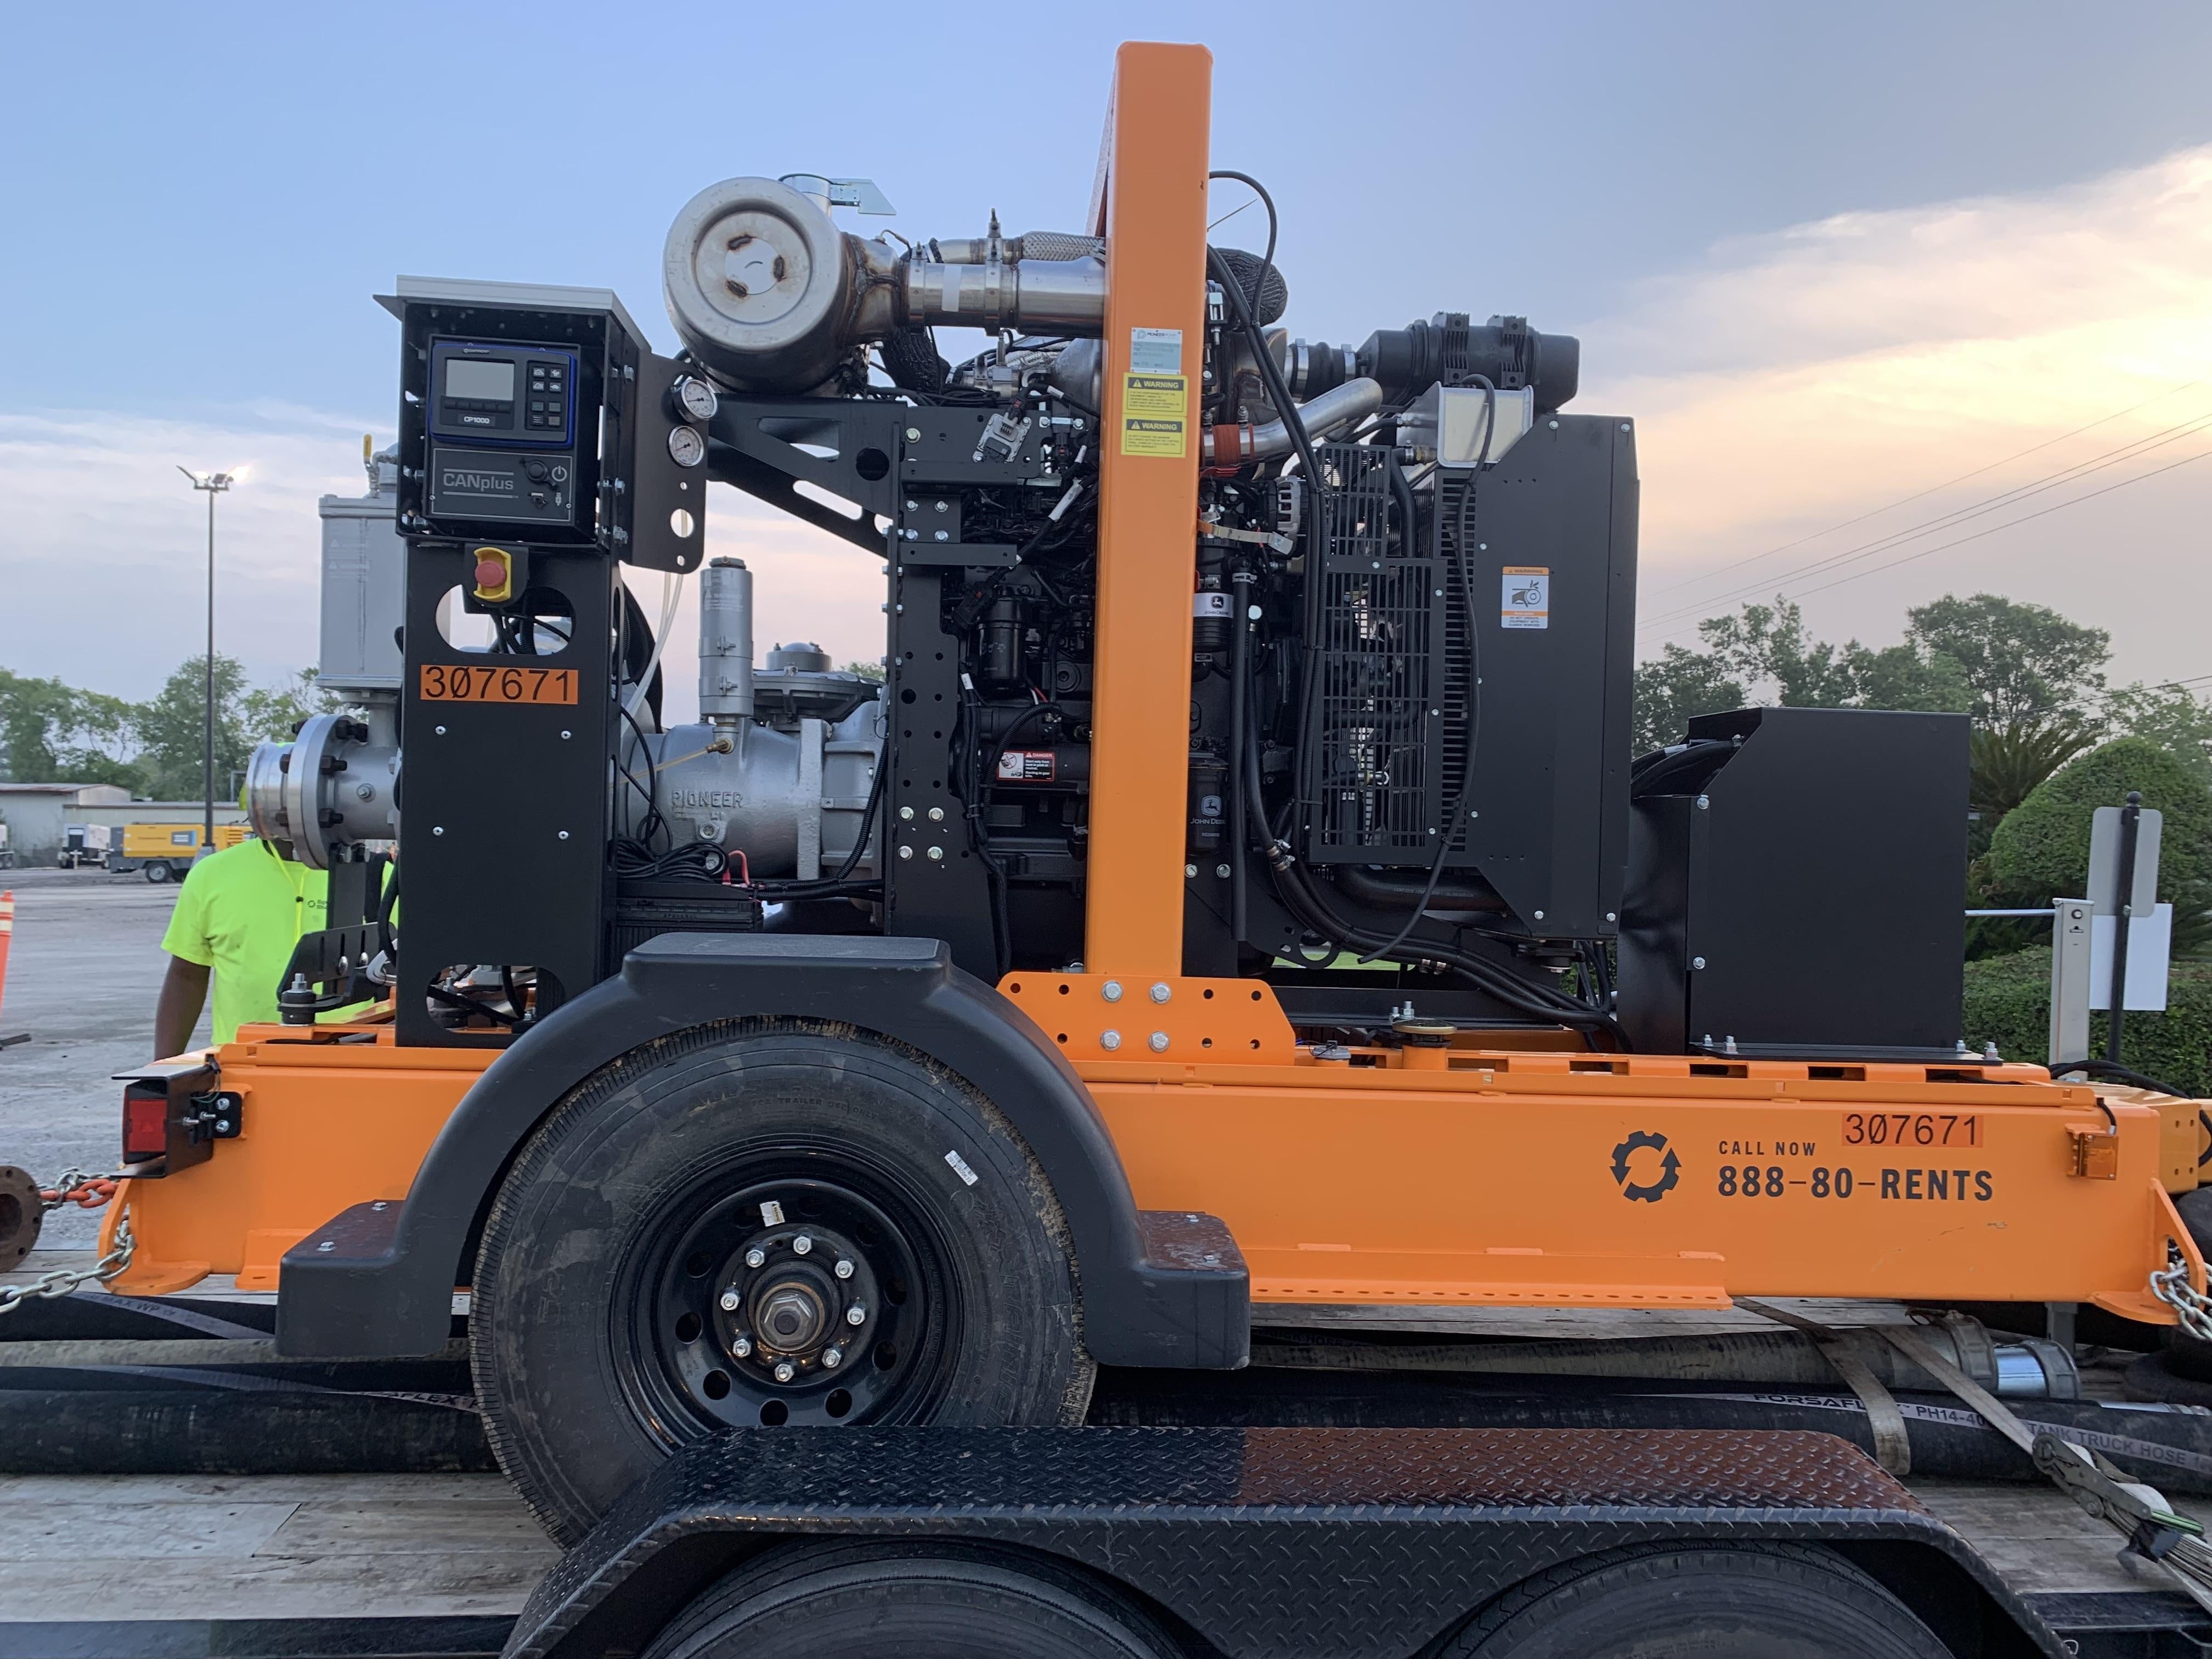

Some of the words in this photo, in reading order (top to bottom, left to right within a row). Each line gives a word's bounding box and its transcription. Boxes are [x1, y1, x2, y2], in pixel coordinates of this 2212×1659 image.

[1143, 380, 1179, 388] WARNING
[464, 416, 490, 424] CP1000
[1142, 422, 1177, 431] WARNING
[443, 473, 514, 492] CANplus
[425, 666, 568, 702] 307671
[672, 789, 743, 808] PIONEER
[778, 1097, 822, 1106] TRAILER
[1846, 1114, 1976, 1146] 307671
[1719, 1141, 1765, 1156] CALL
[1775, 1142, 1816, 1156] NOW
[1718, 1165, 1994, 1201] 888-80-RENTS
[1753, 1394, 1903, 1415] FORSAFL
[1916, 1406, 1986, 1427] PH14-40
[2028, 1423, 2072, 1441] TANK
[2077, 1431, 2134, 1453] TRUCK
[2141, 1444, 2186, 1465] HOSE
